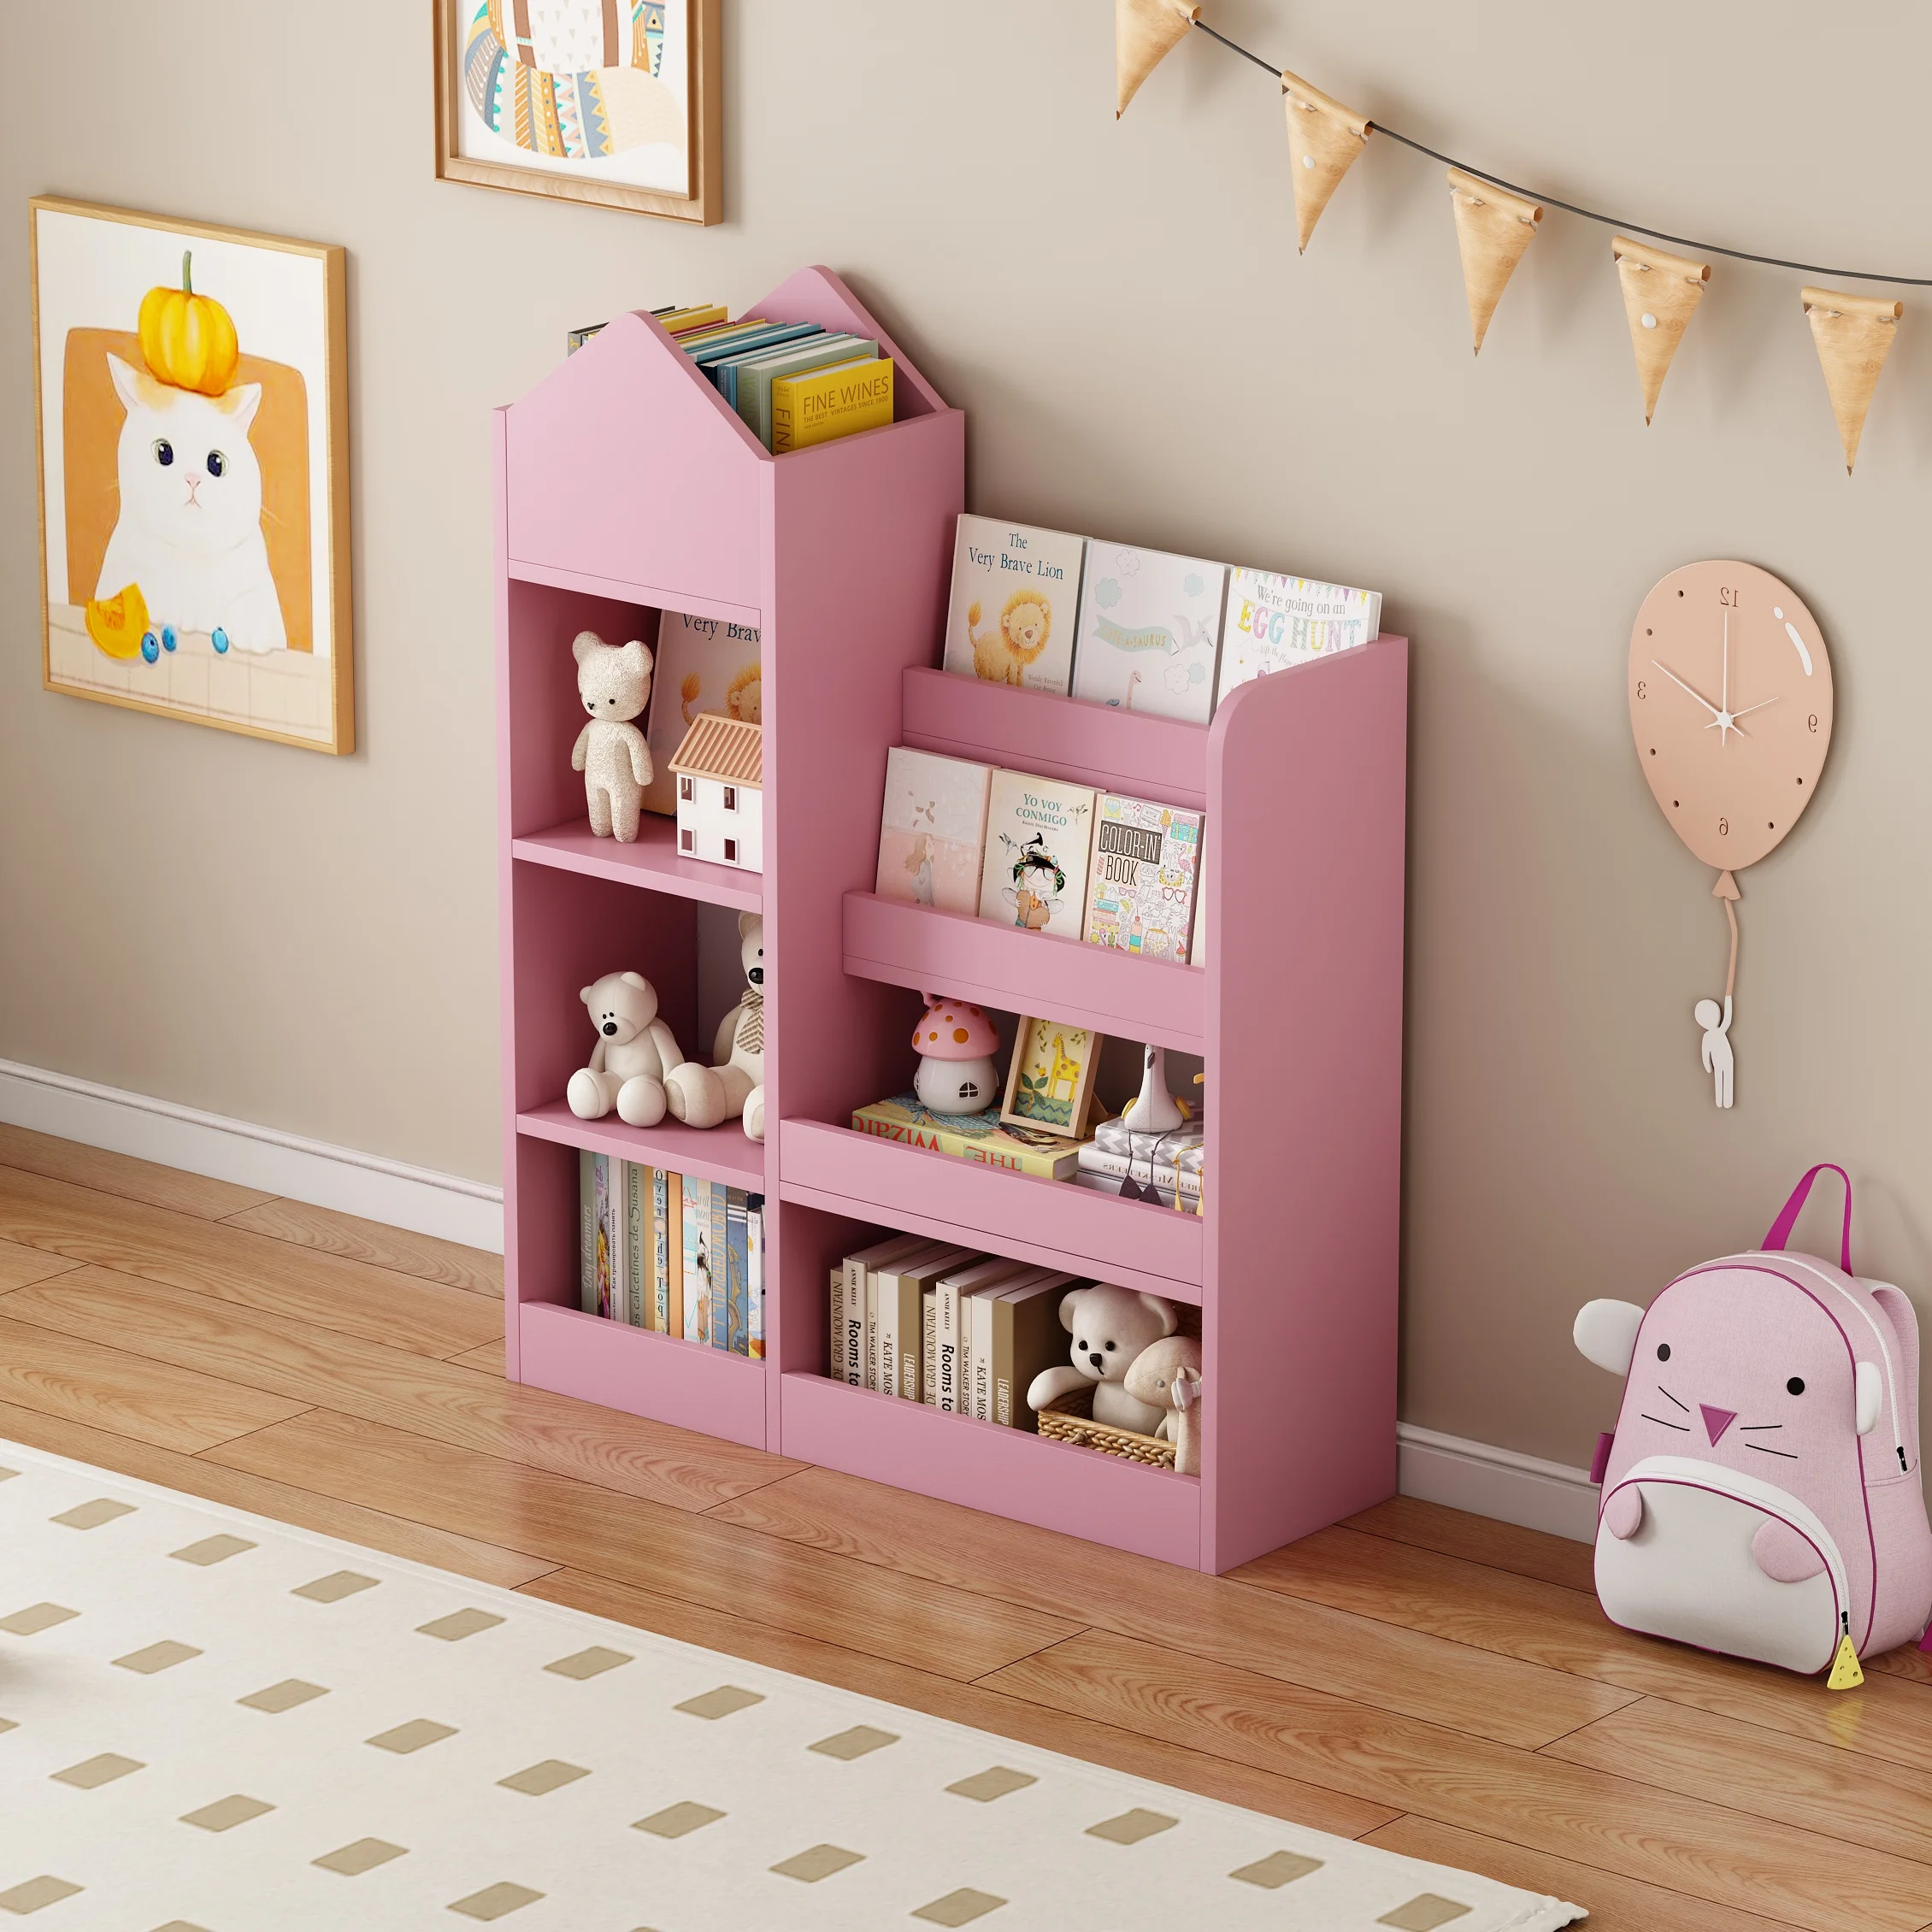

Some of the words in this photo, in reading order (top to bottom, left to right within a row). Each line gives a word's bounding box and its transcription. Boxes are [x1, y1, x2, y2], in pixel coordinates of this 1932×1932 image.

[804, 390, 836, 415] FINE
[840, 376, 889, 404] WINES
[804, 415, 814, 424] THE
[815, 411, 828, 421] BEST
[830, 403, 857, 416] VINTAGES
[858, 399, 874, 409] SINCE
[875, 395, 888, 404] 1900
[1009, 533, 1028, 550] The
[969, 547, 995, 572] Very
[999, 553, 1033, 574] Brave
[1037, 561, 1063, 580] Lion
[1258, 585, 1283, 607] We're
[1285, 598, 1314, 617] going
[1316, 604, 1330, 615] on
[1333, 604, 1346, 615] an
[683, 613, 719, 641] Very
[1238, 598, 1285, 645] EGG
[1289, 616, 1362, 652] HUNT
[1016, 807, 1068, 827] CONMIGO
[1041, 799, 1062, 812] VOY
[1105, 855, 1139, 886] BOOK
[966, 1146, 1021, 1172] THE
[628, 1169, 640, 1222] Susana
[580, 1205, 592, 1261] dreamers
[629, 1225, 639, 1241] de
[582, 1262, 598, 1288] Day
[629, 1245, 640, 1310] calcetines
[833, 1281, 844, 1337] MOUNTAIN
[848, 1319, 862, 1369] Rooms
[926, 1305, 936, 1362] MOUNTAIN
[833, 1336, 844, 1363] GRAY
[883, 1340, 893, 1370] KATE
[848, 1372, 861, 1387] to
[903, 1352, 916, 1400] LEADERSHIP
[926, 1361, 936, 1387] GRAY
[941, 1344, 955, 1393] Rooms
[976, 1365, 987, 1396] KATE
[883, 1372, 893, 1396] MOS
[926, 1391, 936, 1405] DE
[941, 1397, 954, 1412] to
[976, 1396, 987, 1422] MOS
[997, 1377, 1010, 1426] LEADERSHIP
